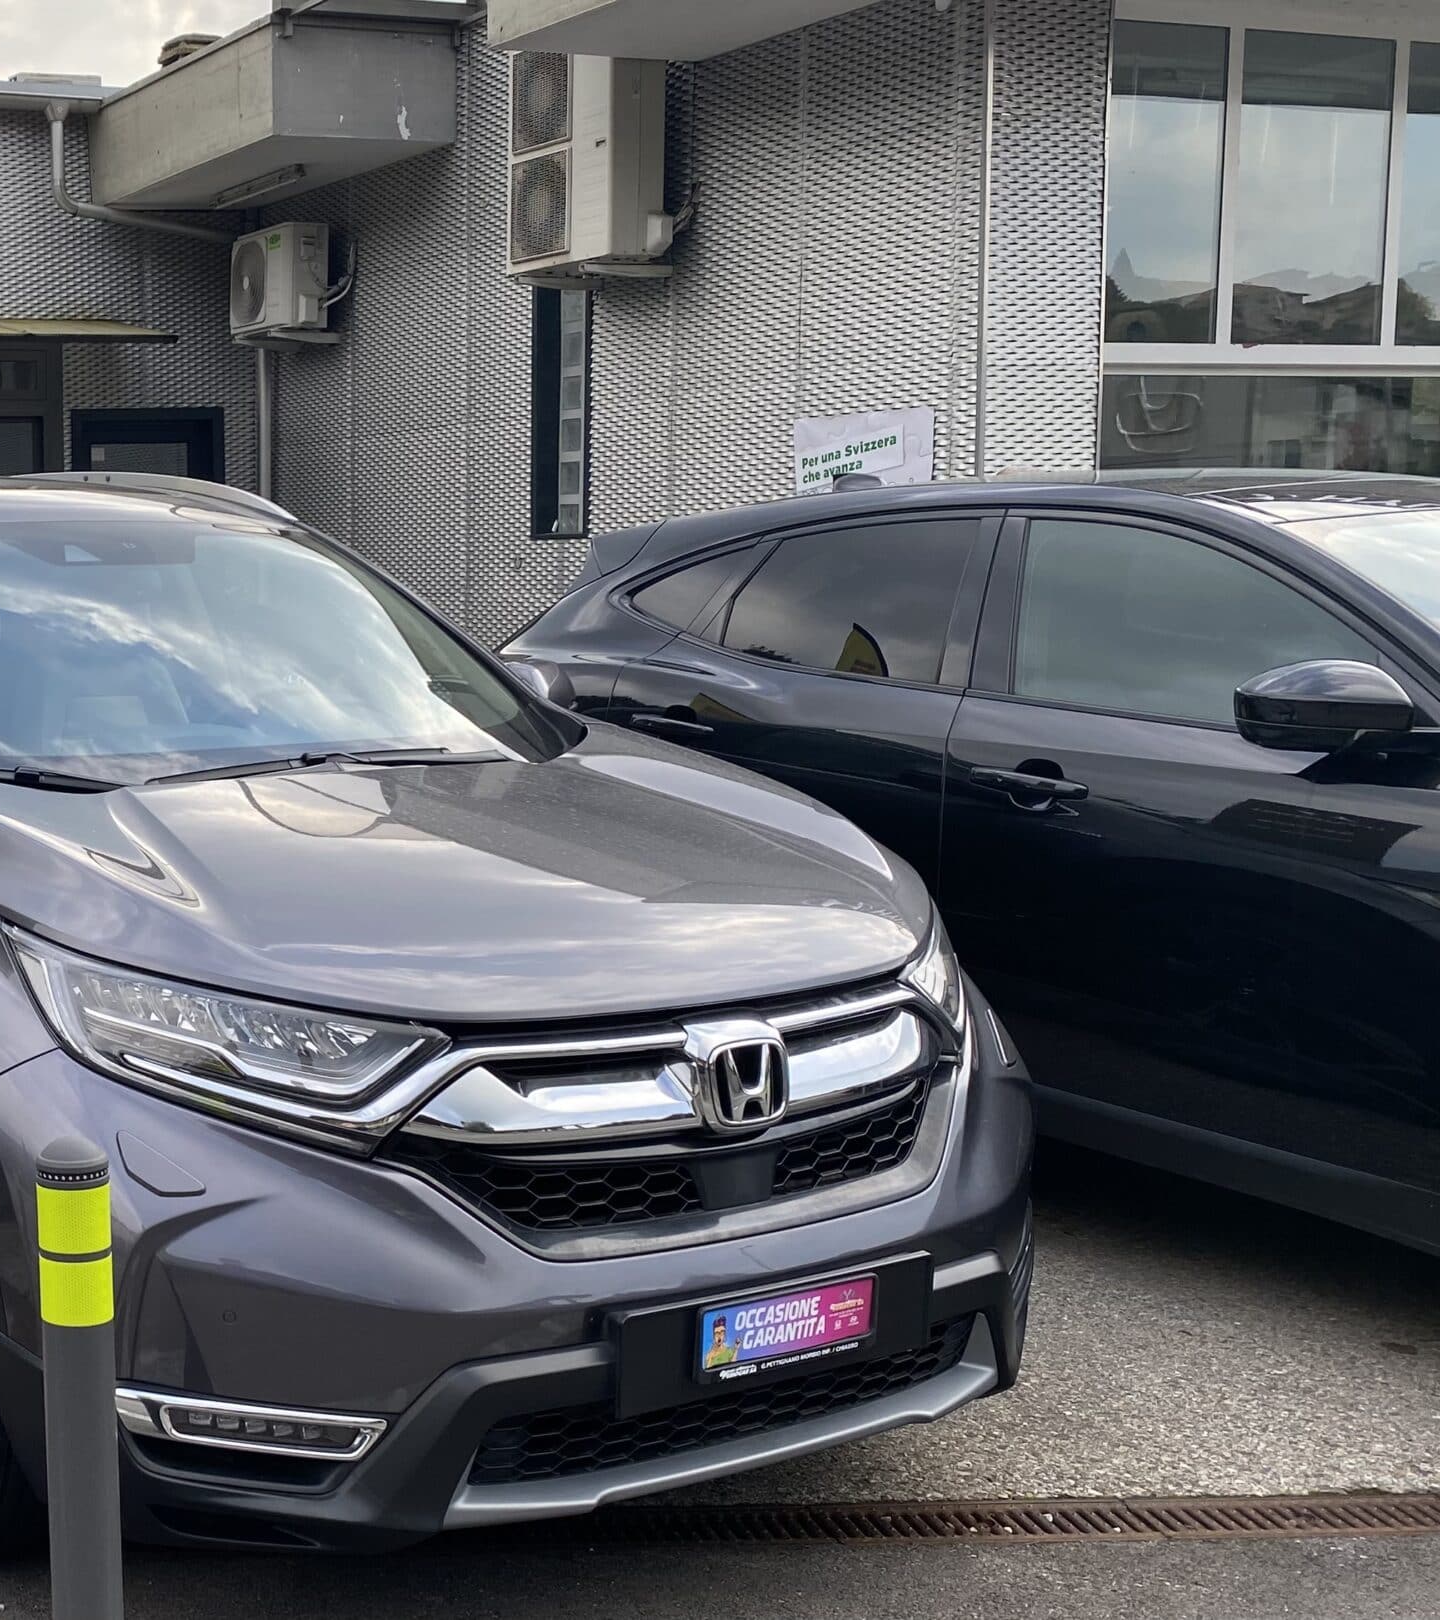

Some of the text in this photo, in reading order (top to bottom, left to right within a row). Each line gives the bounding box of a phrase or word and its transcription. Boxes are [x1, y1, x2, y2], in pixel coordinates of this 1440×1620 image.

[802, 434, 897, 470] Per una Svizzera
[802, 458, 863, 484] che avanza
[735, 1296, 821, 1331] OCCASIONE
[743, 1315, 826, 1350] GARANTITA
